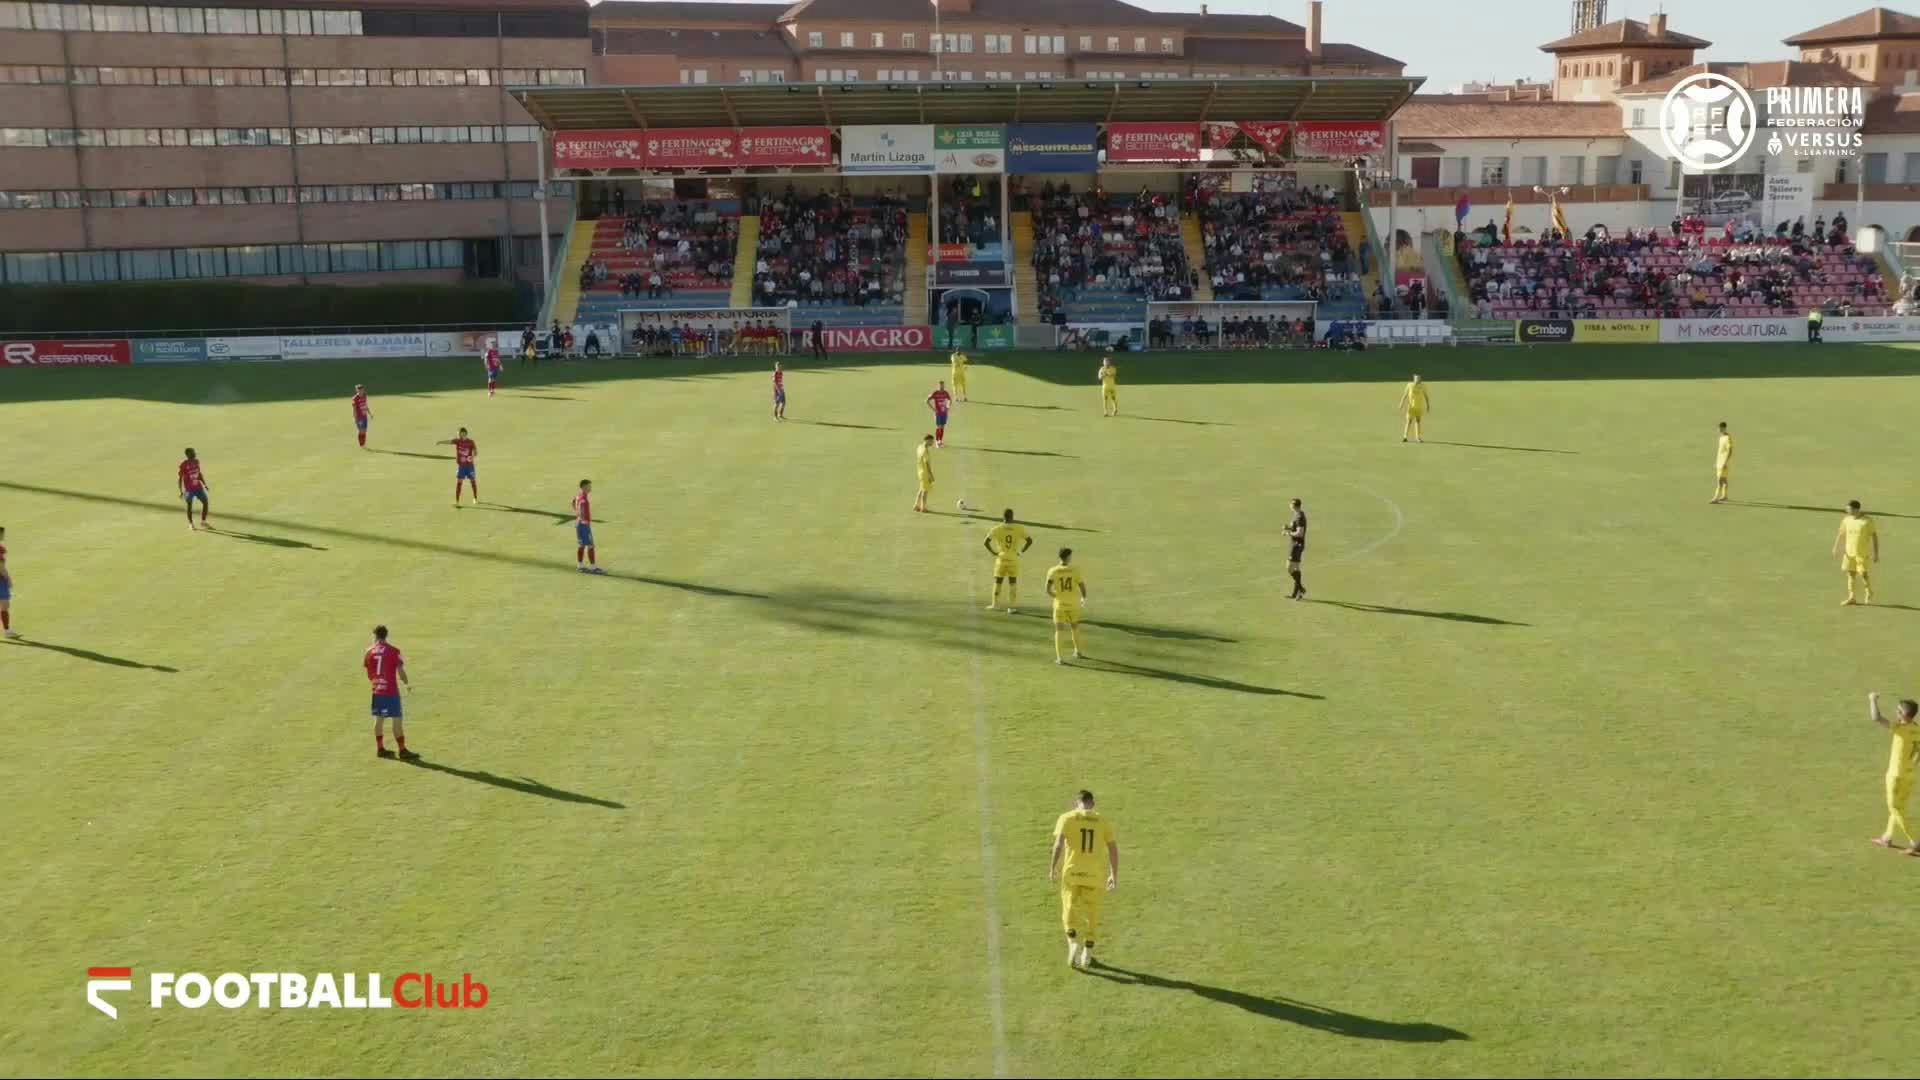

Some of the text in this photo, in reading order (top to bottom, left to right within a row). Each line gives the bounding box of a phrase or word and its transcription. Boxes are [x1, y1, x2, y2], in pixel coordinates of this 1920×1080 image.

[1125, 132, 1195, 142] FERTINAGRO
[1311, 130, 1380, 140] FERTINAGRO
[661, 138, 732, 149] FERTINAGRO
[754, 137, 824, 147] FERTINAGRO
[889, 151, 925, 165] Lizaga
[1527, 324, 1568, 335] embou
[1699, 324, 1788, 337] MOSQUITURIA
[281, 337, 350, 348] TALLERES
[1005, 534, 1012, 549] 9
[1059, 576, 1073, 592] 14
[374, 655, 382, 676] 7
[1080, 828, 1095, 853] 11
